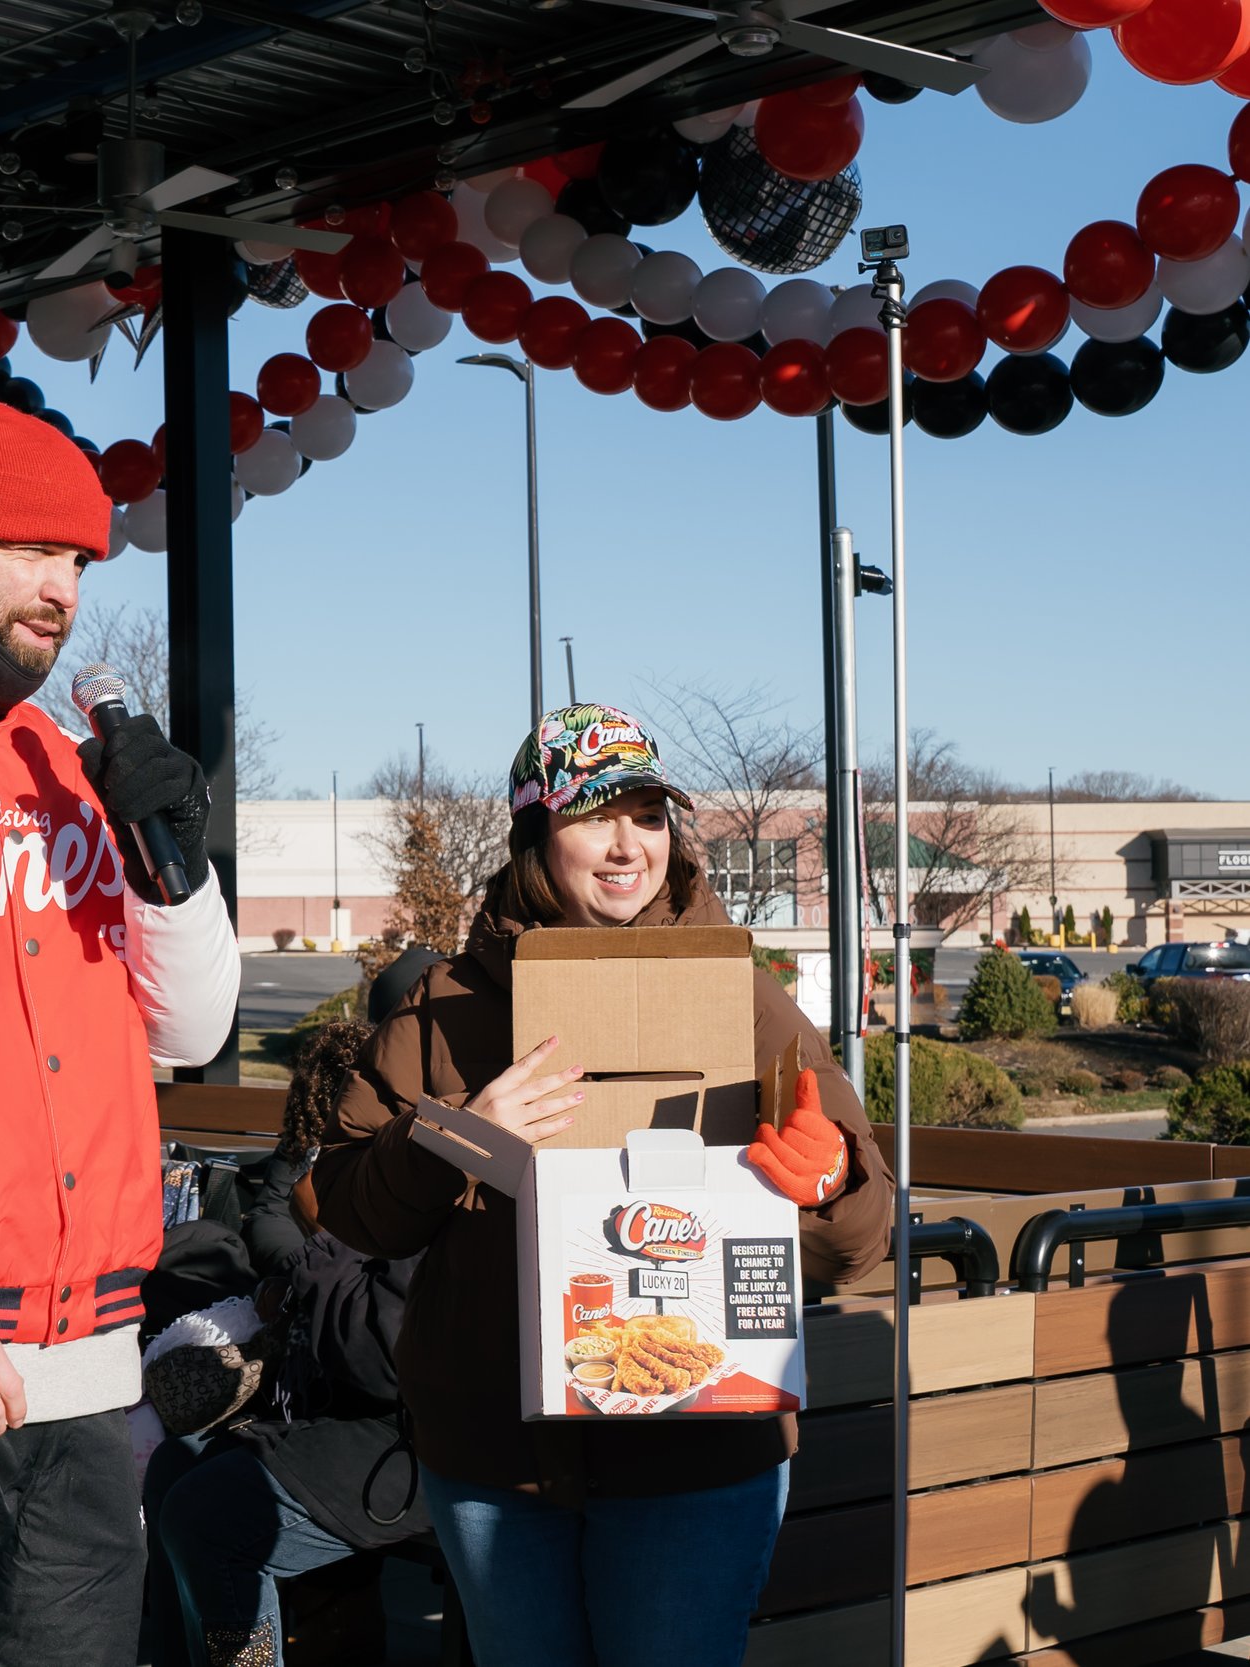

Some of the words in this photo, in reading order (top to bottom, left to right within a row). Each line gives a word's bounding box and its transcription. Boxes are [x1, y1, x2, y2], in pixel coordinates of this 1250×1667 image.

[1219, 855, 1250, 866] FLOO
[652, 1206, 684, 1220] Raising
[619, 1200, 706, 1251] Cane's
[732, 1245, 769, 1255] REGISTER
[770, 1245, 785, 1255] FOR
[734, 1258, 740, 1267] A
[741, 1258, 772, 1267] CHANCE
[773, 1257, 784, 1267] TO
[740, 1270, 750, 1280] BE
[751, 1270, 768, 1280] ONE
[768, 1270, 779, 1280] OF
[642, 1274, 672, 1290] LUCKY
[674, 1277, 685, 1291] 20
[733, 1282, 749, 1292] THE
[750, 1282, 775, 1292] LUCKY
[776, 1282, 787, 1292] 20
[729, 1294, 762, 1304] CANIACS
[764, 1294, 774, 1304] TO
[775, 1294, 792, 1304] WIN
[572, 1303, 611, 1323] Cane's
[736, 1307, 756, 1317] FREE
[757, 1307, 786, 1316] CANE'S
[738, 1319, 753, 1329] FOR
[754, 1319, 760, 1329] A
[761, 1319, 785, 1329] YEAR!
